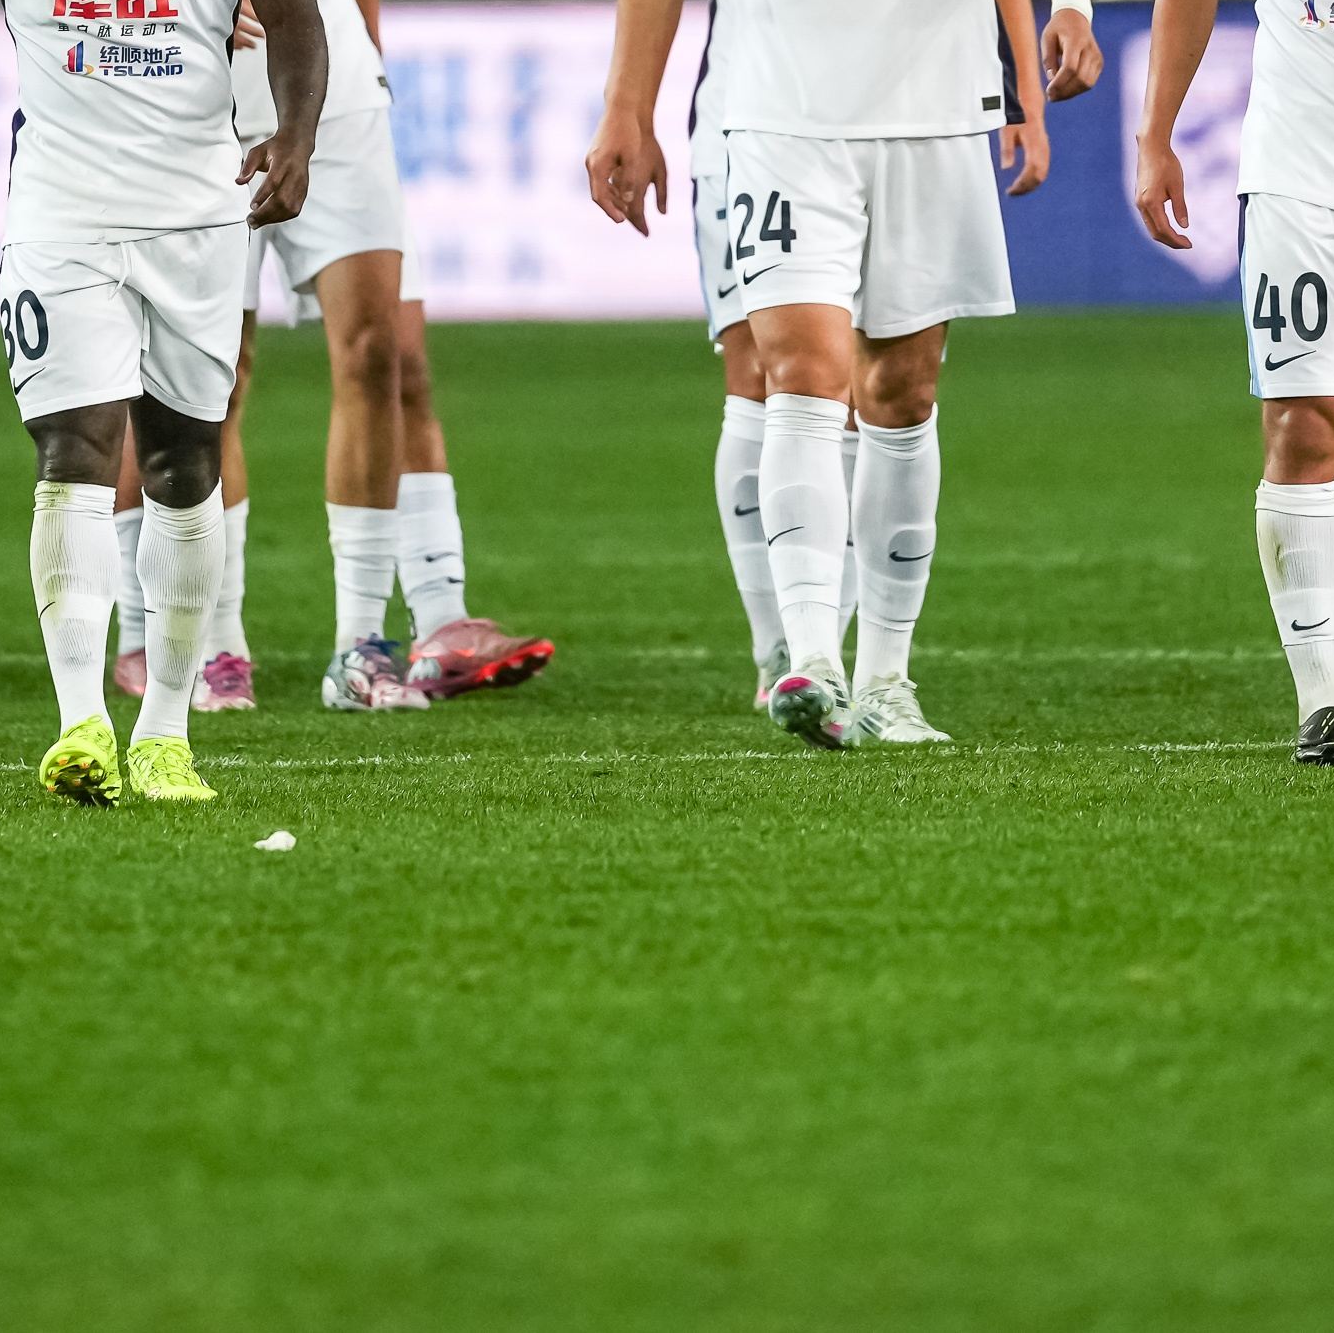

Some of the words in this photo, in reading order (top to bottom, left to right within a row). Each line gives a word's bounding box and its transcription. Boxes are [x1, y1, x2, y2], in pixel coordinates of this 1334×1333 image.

[99, 64, 183, 77] TSLAND
[100, 46, 182, 64] 统顺地产
[733, 190, 797, 261] 24
[1253, 272, 1328, 343] 40
